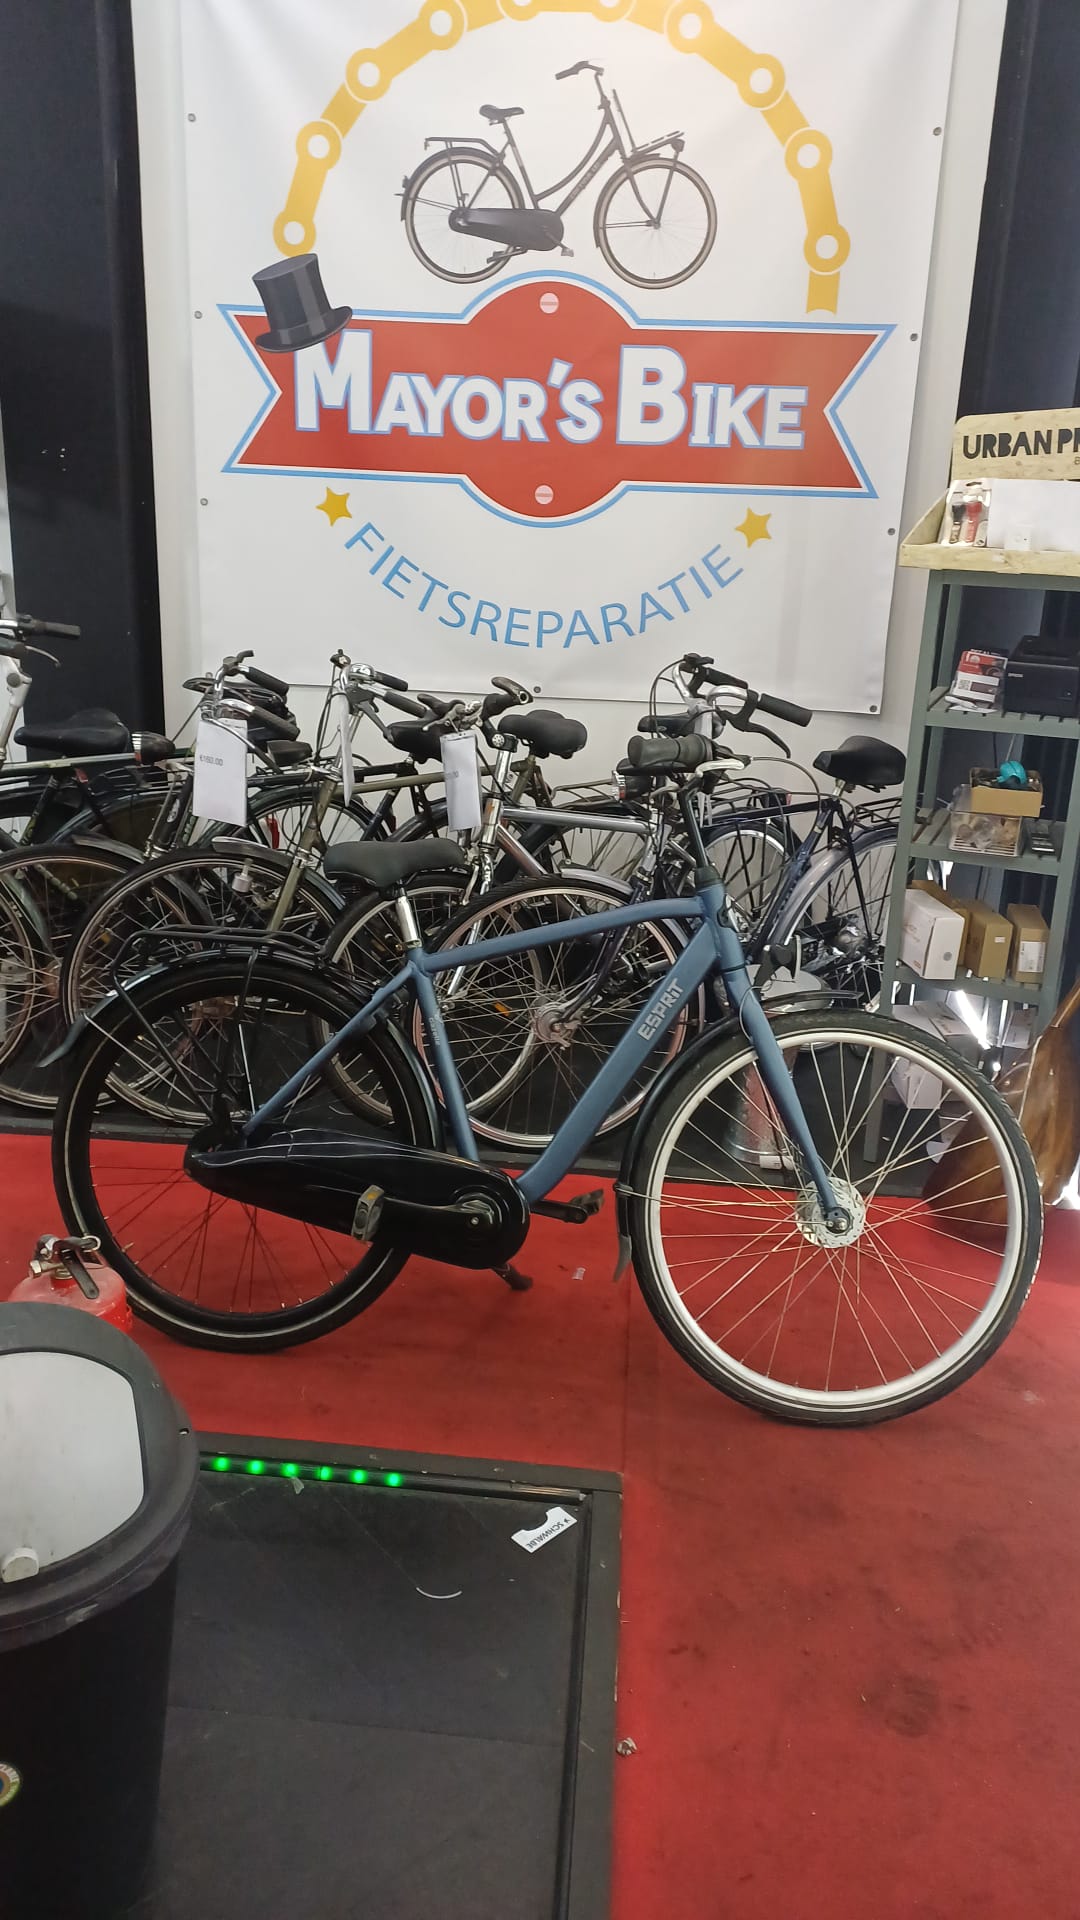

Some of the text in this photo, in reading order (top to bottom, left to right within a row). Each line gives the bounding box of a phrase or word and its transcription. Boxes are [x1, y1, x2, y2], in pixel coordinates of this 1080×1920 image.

[294, 329, 808, 449] MAYOR'S BIKE
[962, 429, 1052, 459] URBAN
[344, 522, 744, 649] FIETSREPARATIE
